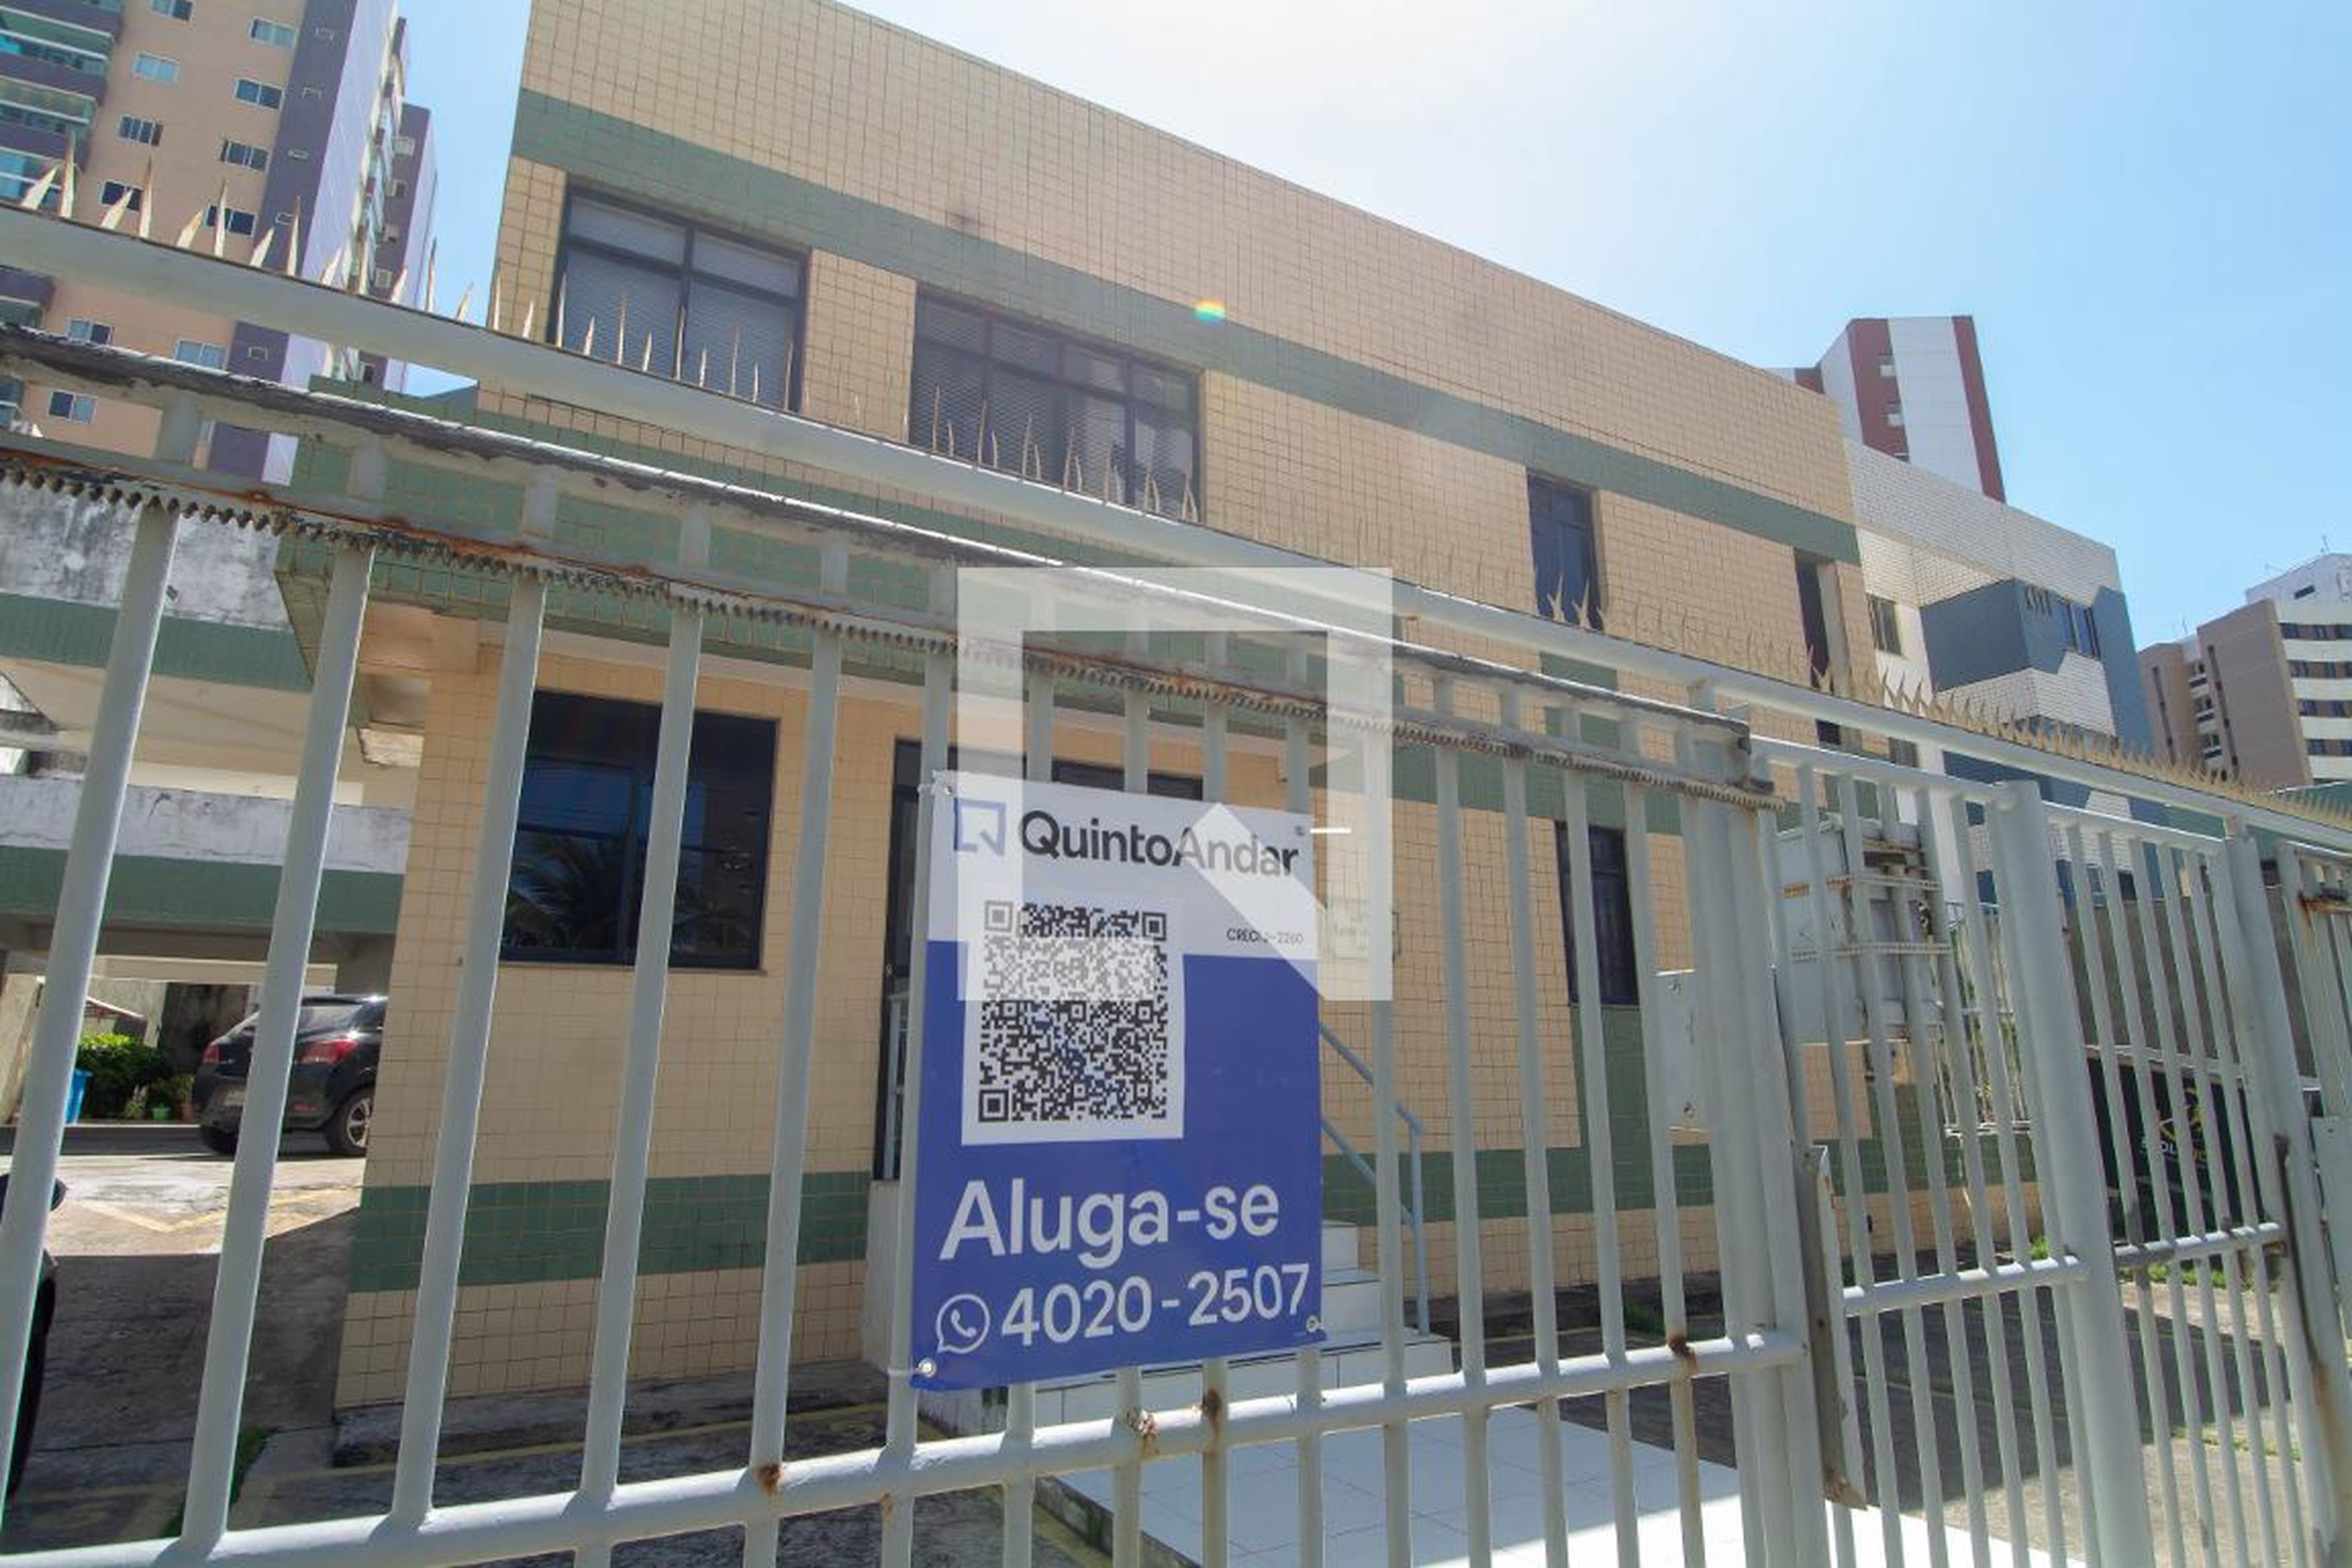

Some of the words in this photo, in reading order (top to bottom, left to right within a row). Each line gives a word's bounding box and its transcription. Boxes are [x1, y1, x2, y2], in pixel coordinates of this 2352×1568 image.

[1021, 810, 1299, 877] QuintoAndar
[938, 1178, 1279, 1269] Aluga-se
[1001, 1263, 1310, 1346] 4020-2507
